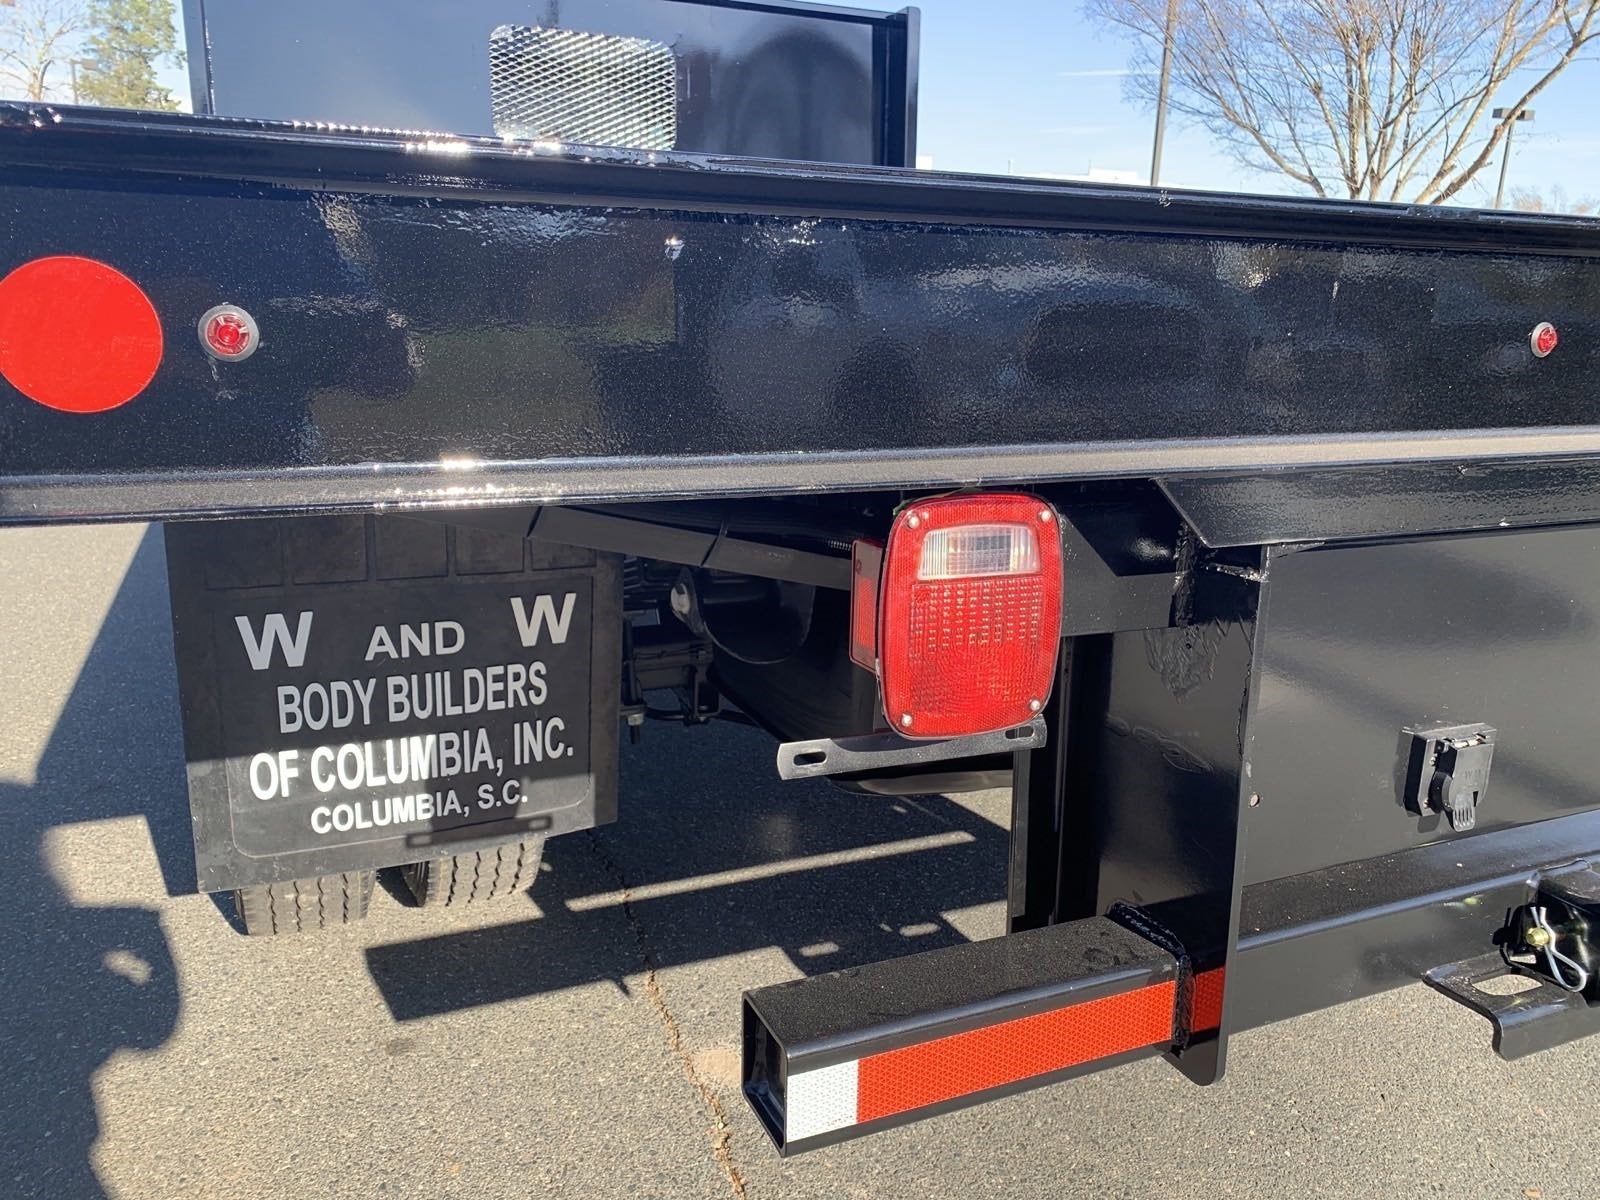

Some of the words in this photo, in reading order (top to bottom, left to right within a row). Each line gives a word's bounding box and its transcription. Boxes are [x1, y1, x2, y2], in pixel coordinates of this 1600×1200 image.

[235, 612, 313, 670] W
[365, 620, 465, 660] AND
[510, 592, 577, 646] W
[277, 679, 376, 734] BODY
[387, 661, 548, 724] BUILDERS
[249, 750, 299, 801] OF
[310, 727, 503, 793] COLUMBIA,
[514, 717, 575, 766] INC.
[310, 789, 470, 834] COLUMBIA,
[478, 779, 528, 810] S.C.
